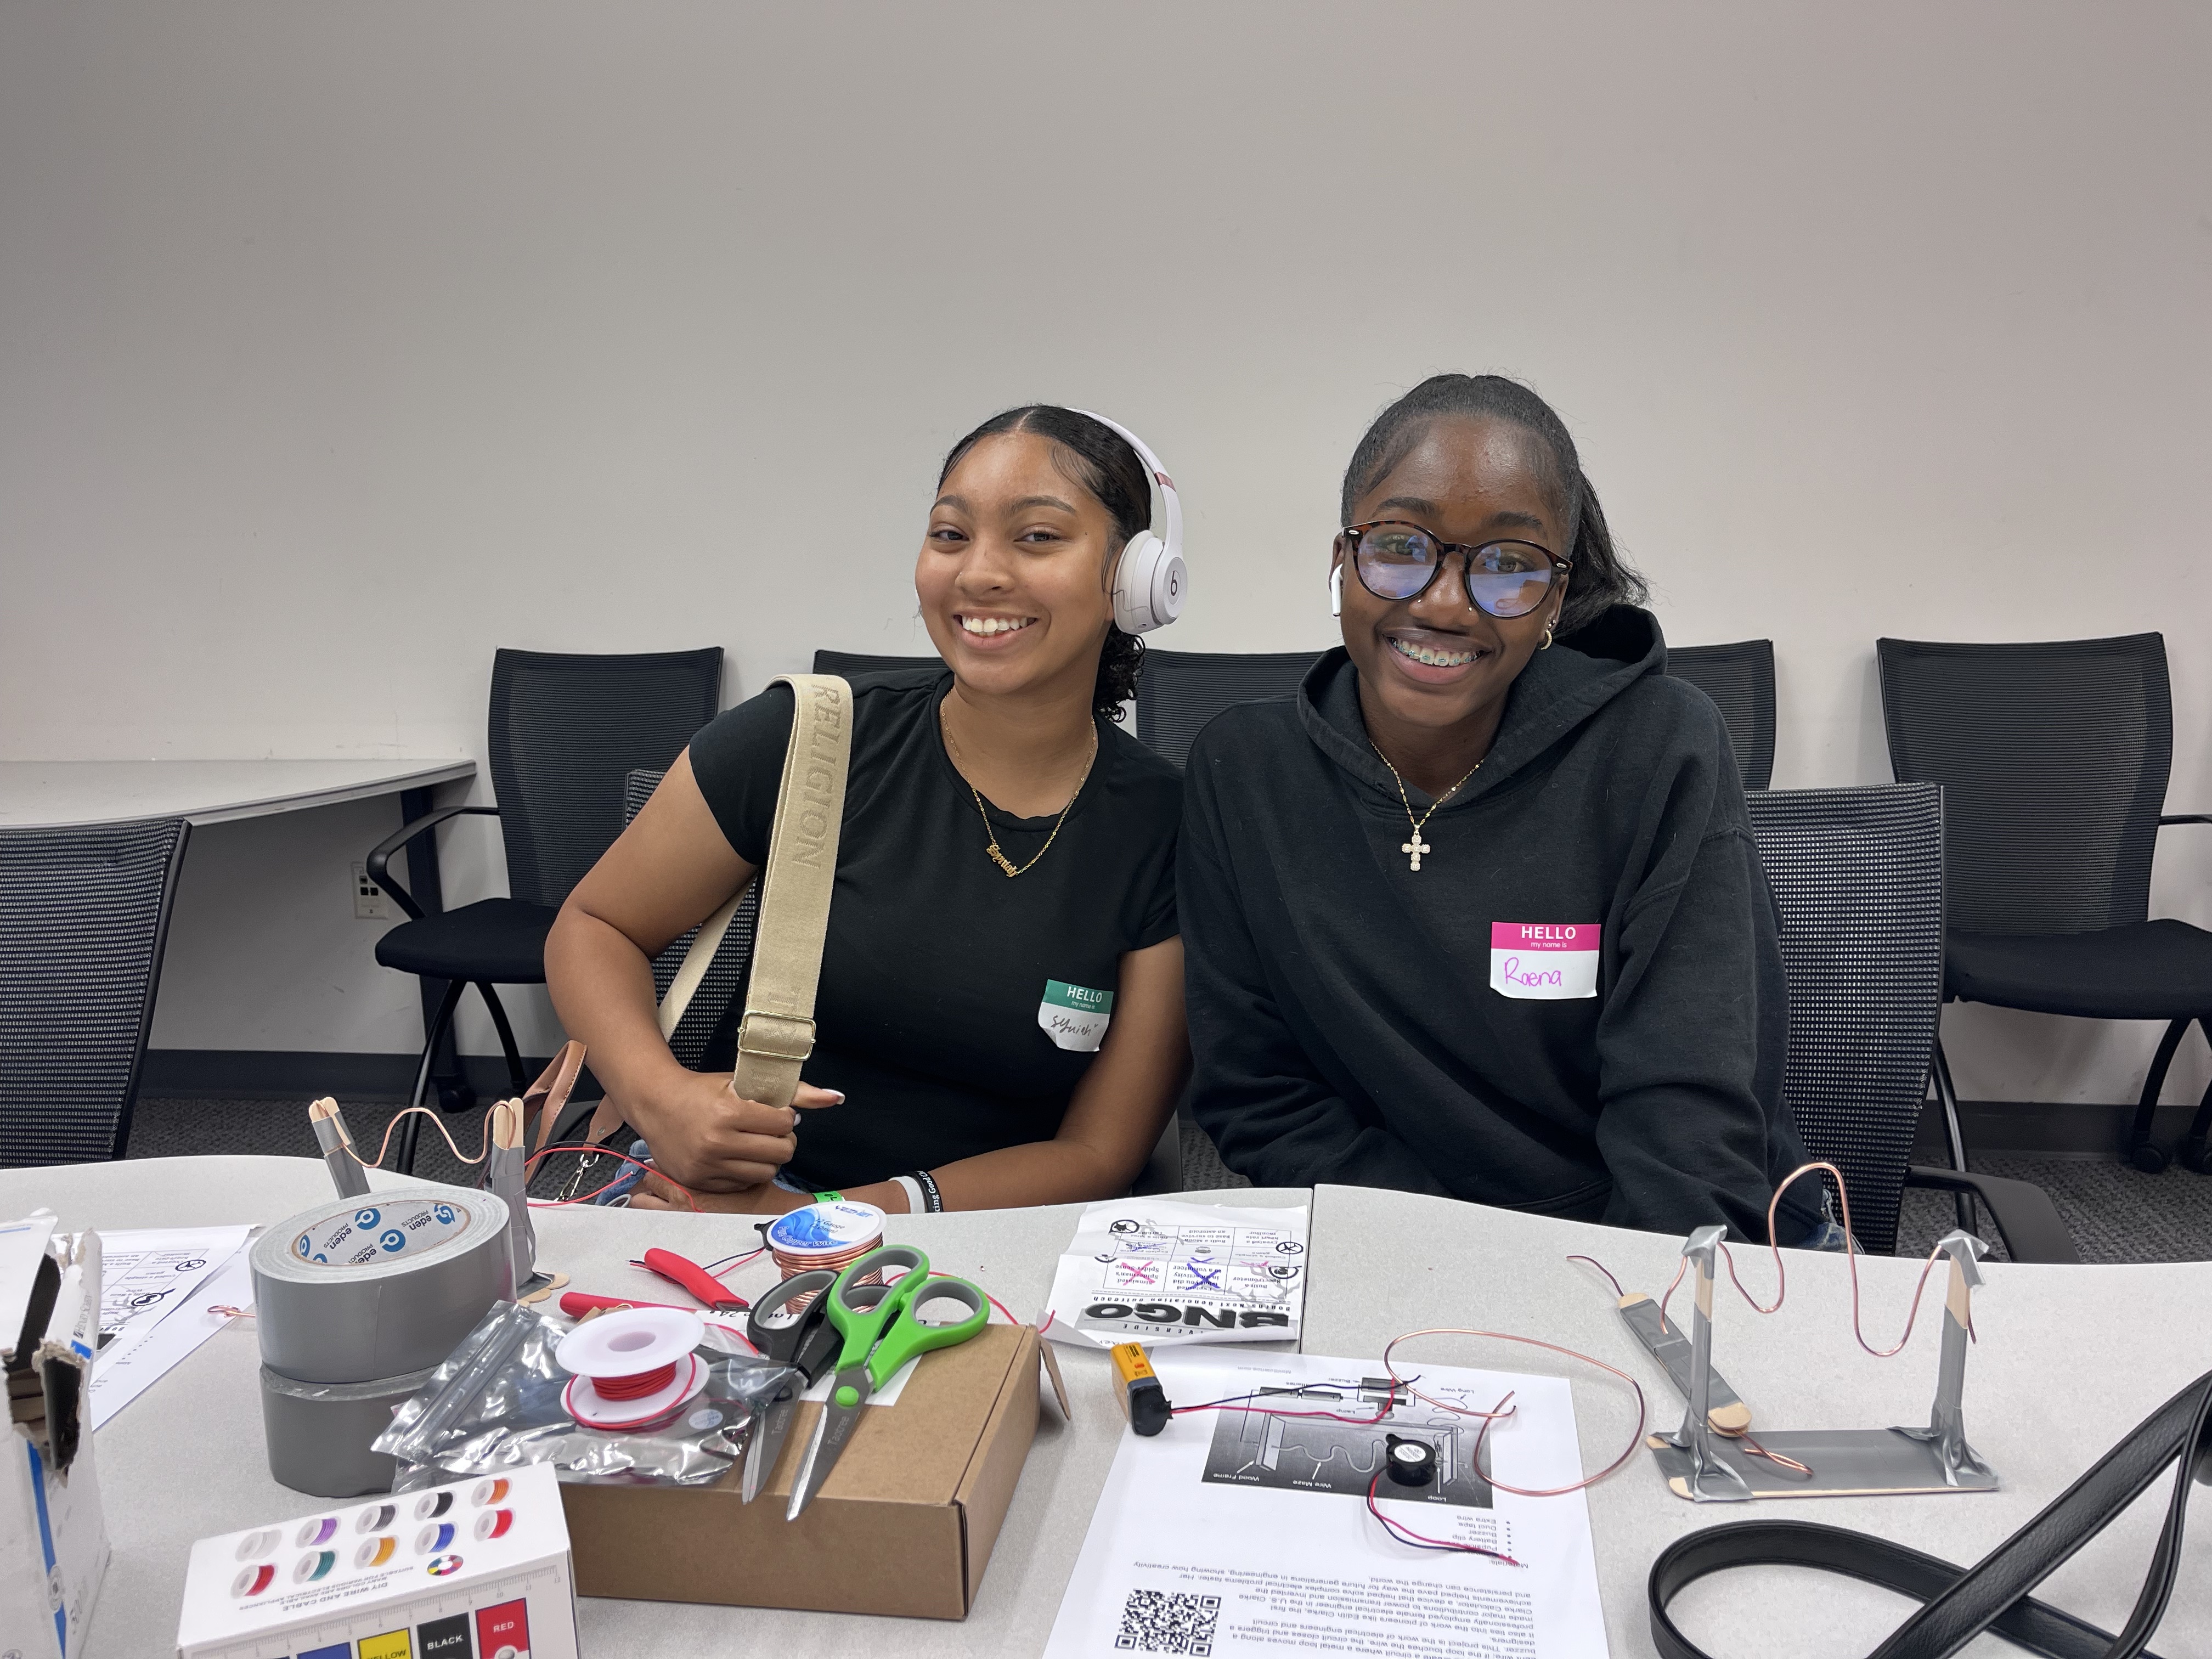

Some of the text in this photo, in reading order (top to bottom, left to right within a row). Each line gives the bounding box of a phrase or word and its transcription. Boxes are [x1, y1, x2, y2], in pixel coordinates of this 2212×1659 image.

[793, 684, 841, 870] RELIGION
[1521, 926, 1576, 940] HELLO
[1505, 957, 1562, 986] Raena
[1066, 986, 1103, 1003] HELLO
[922, 1177, 936, 1194] Good
[401, 1209, 428, 1228] PRODUCTS
[409, 1215, 432, 1231] eden
[823, 1221, 845, 1229] Gauge
[323, 1222, 349, 1249] PRODUCTS
[329, 1228, 352, 1251] eden
[355, 1248, 377, 1265] ede
[1115, 1272, 1159, 1280] Spiderman's
[1150, 1298, 1213, 1306] Generation
[1133, 1561, 1169, 1570] creativity
[1191, 1566, 1225, 1575] showing
[379, 1566, 413, 1577] SUITABLE
[1227, 1569, 1278, 1579] engineering,
[331, 1578, 362, 1588] VARIOUS
[1224, 1577, 1263, 1586] problems
[1265, 1581, 1302, 1590] electrical
[1290, 1576, 1339, 1587] generations
[1412, 1581, 1443, 1589] change
[285, 1585, 330, 1599] ELECTRICAL
[1305, 1586, 1339, 1595] complex
[1463, 1587, 1512, 1597] persistence
[280, 1593, 319, 1605] AVAILABLE
[283, 1582, 387, 1611] DIY WIRE AND CABLE
[1367, 1592, 1396, 1601] helped
[1417, 1597, 1445, 1605] device
[1441, 1592, 1470, 1601] helped
[1472, 1596, 1532, 1606] achievements
[239, 1597, 284, 1611] APPLIANCES
[1271, 1590, 1506, 1620] major contributions power transmission invented
[1456, 1601, 1502, 1612] Calculator,
[1238, 1594, 1534, 1630] professionally employed female electrical engineer Clarke
[1305, 1608, 1335, 1618] Clarke,
[1504, 1607, 1532, 1615] Clarke
[1253, 1619, 1278, 1627] circuit
[1380, 1617, 1417, 1626] pioneers
[493, 1622, 515, 1633] RED
[1238, 1626, 1269, 1635] triggers
[1300, 1624, 1342, 1634] engineers
[1292, 1632, 1319, 1640] closes
[1345, 1629, 1384, 1639] electrical
[427, 1634, 465, 1651] BLACK
[1240, 1633, 1412, 1659] circuit where metal loop moves along
[1448, 1640, 1479, 1649] project
[1489, 1637, 1535, 1646] designers.
[1408, 1645, 1443, 1655] touches
